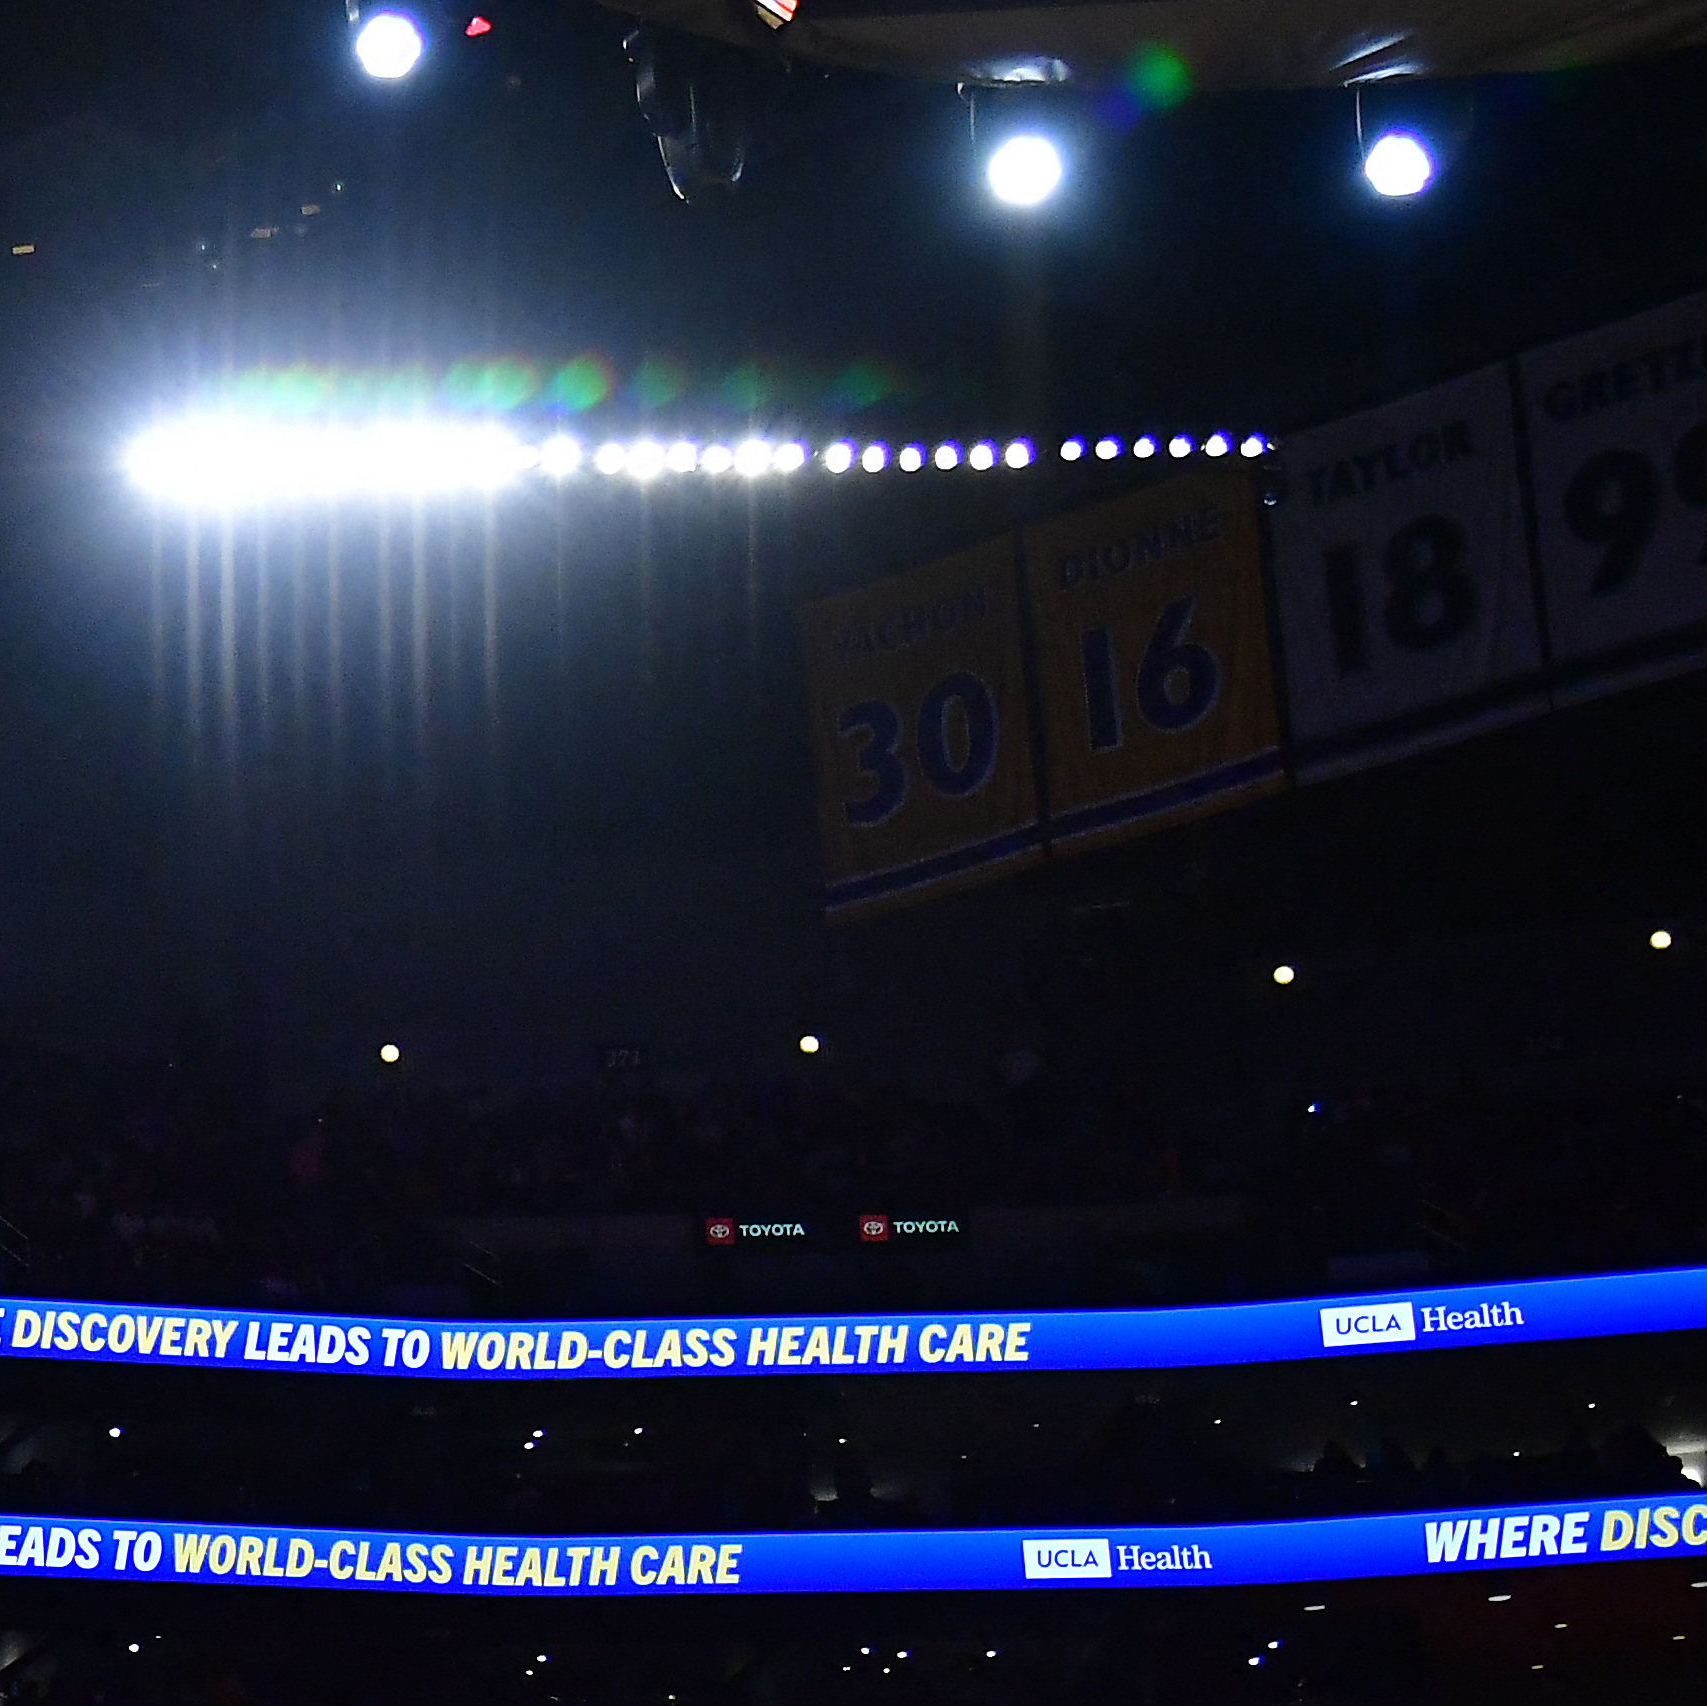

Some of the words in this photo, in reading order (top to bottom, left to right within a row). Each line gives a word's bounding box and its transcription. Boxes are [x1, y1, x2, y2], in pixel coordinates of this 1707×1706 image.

[1544, 338, 1707, 421] GRETZ
[1304, 419, 1473, 506] TAYLOR
[1057, 507, 1222, 592] DIONNE
[1324, 514, 1478, 675] 18
[1082, 595, 1220, 755] 16
[836, 671, 998, 828] 30
[739, 1223, 805, 1238] TOYOTA
[894, 1220, 959, 1234] TOYOTA
[12, 1309, 238, 1358] DISCOVERY
[244, 1322, 371, 1366] LEADS
[382, 1328, 430, 1369] TO
[441, 1326, 737, 1370] WORLD-CLASS
[746, 1325, 907, 1367] HEALTH
[918, 1322, 1031, 1365] CARE
[1335, 1315, 1402, 1338] UCLA
[1420, 1301, 1524, 1335] Health
[113, 1530, 162, 1571] TO
[173, 1533, 453, 1584] WORLD-CLASS
[463, 1545, 619, 1587] HEALTH
[630, 1544, 742, 1587] CARE
[1037, 1548, 1099, 1570] UCLA
[1117, 1544, 1212, 1572] Health
[1425, 1512, 1590, 1564] WHERE
